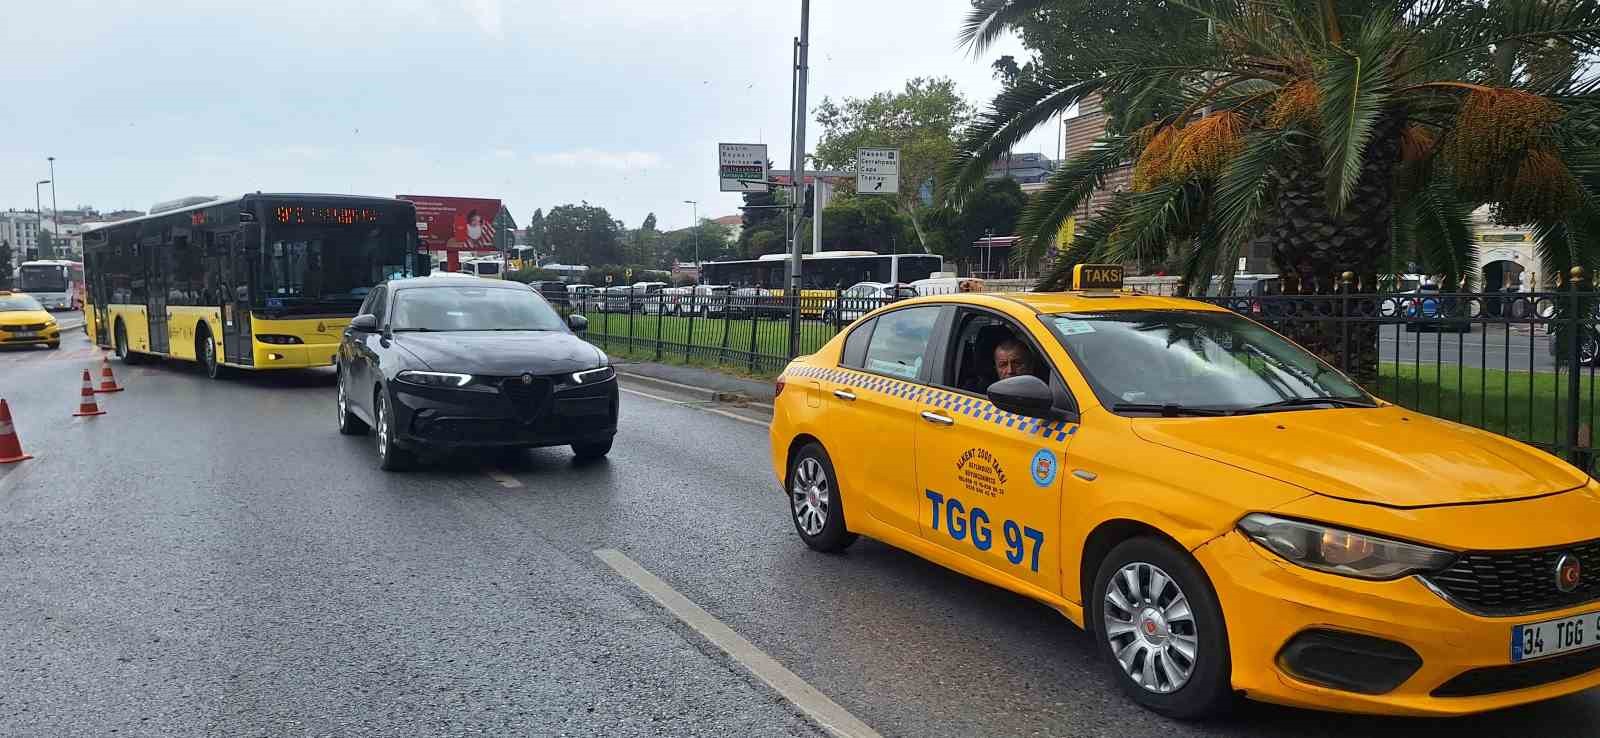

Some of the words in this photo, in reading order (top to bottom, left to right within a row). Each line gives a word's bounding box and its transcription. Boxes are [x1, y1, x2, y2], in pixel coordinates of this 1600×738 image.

[956, 448, 975, 470] ALKENT
[977, 448, 992, 463] 2000
[925, 488, 992, 552] TGG
[1003, 519, 1045, 573] 97
[1524, 627, 1544, 655] 34
[1557, 619, 1584, 649] TGG
